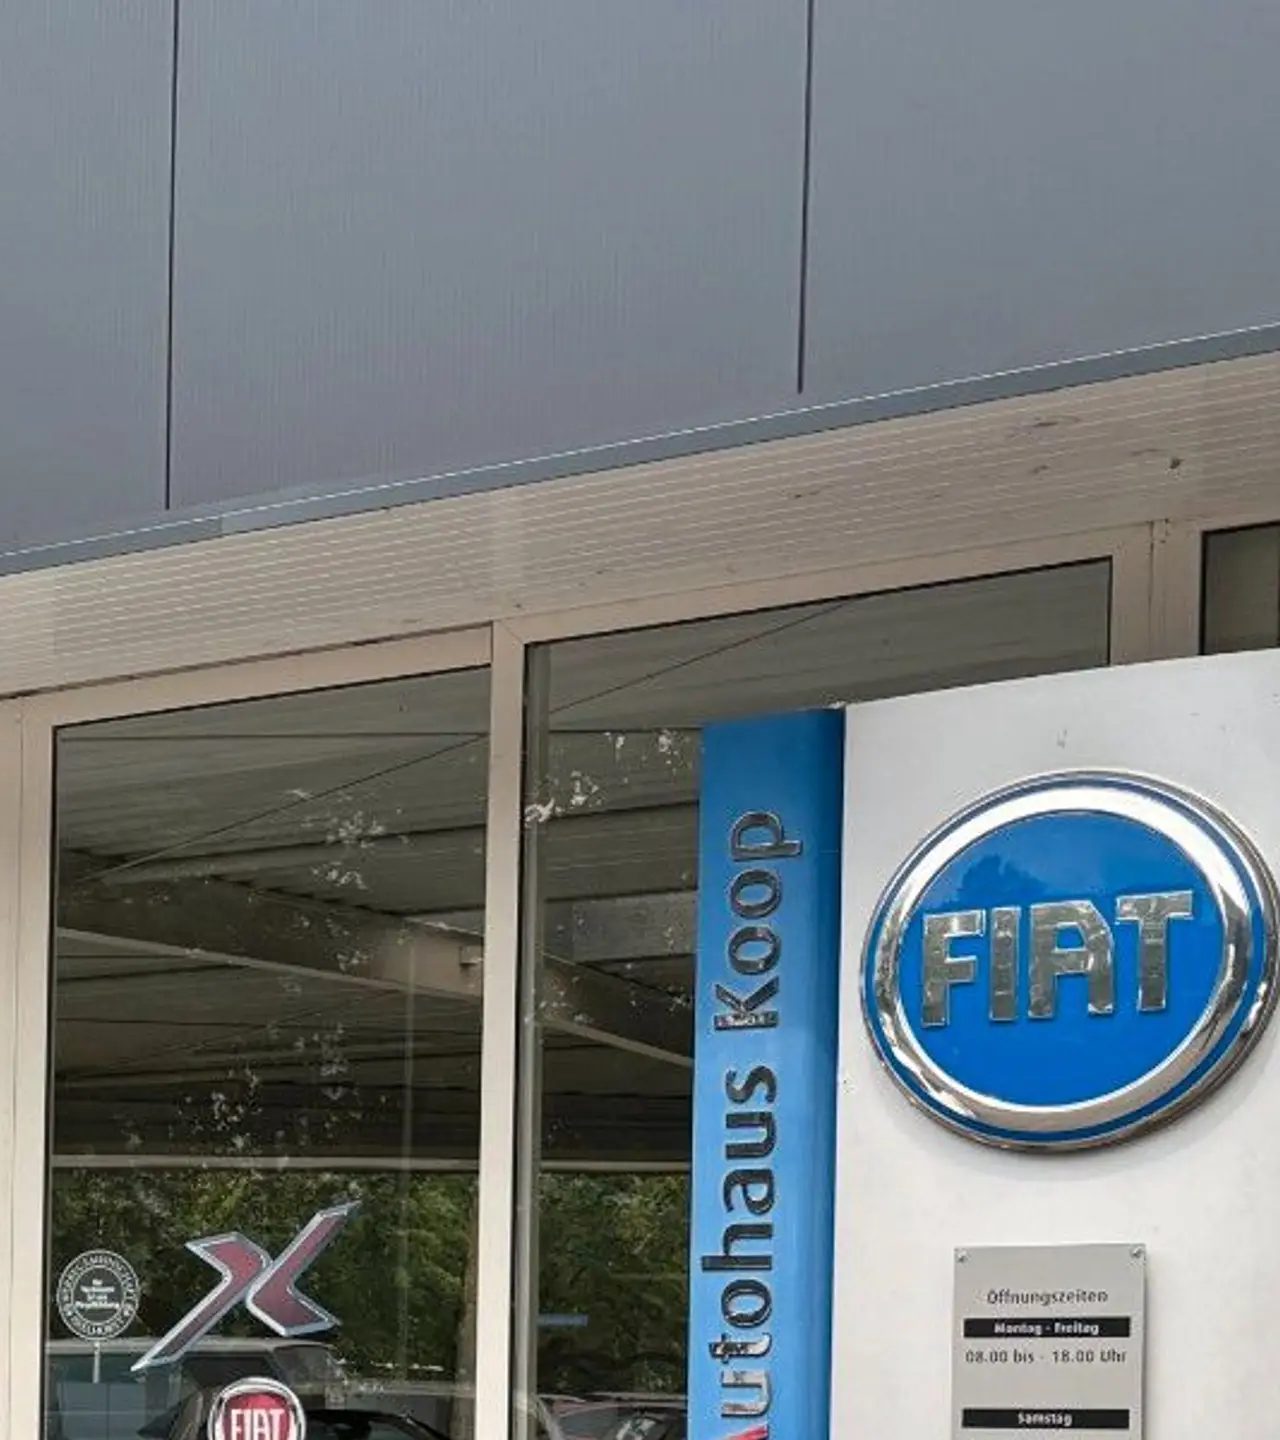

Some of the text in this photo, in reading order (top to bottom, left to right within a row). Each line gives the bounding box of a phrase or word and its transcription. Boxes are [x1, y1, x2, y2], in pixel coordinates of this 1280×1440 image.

[714, 810, 803, 1031] Koop
[919, 890, 1194, 1027] FIAT
[994, 1322, 1043, 1337] Montag
[1054, 1321, 1100, 1336] Freitag
[965, 1350, 1008, 1363] 08.00
[1013, 1349, 1035, 1363] bis
[1052, 1350, 1095, 1363] 18.00
[1100, 1349, 1127, 1363] Uhr
[1017, 1411, 1073, 1427] Samstag
